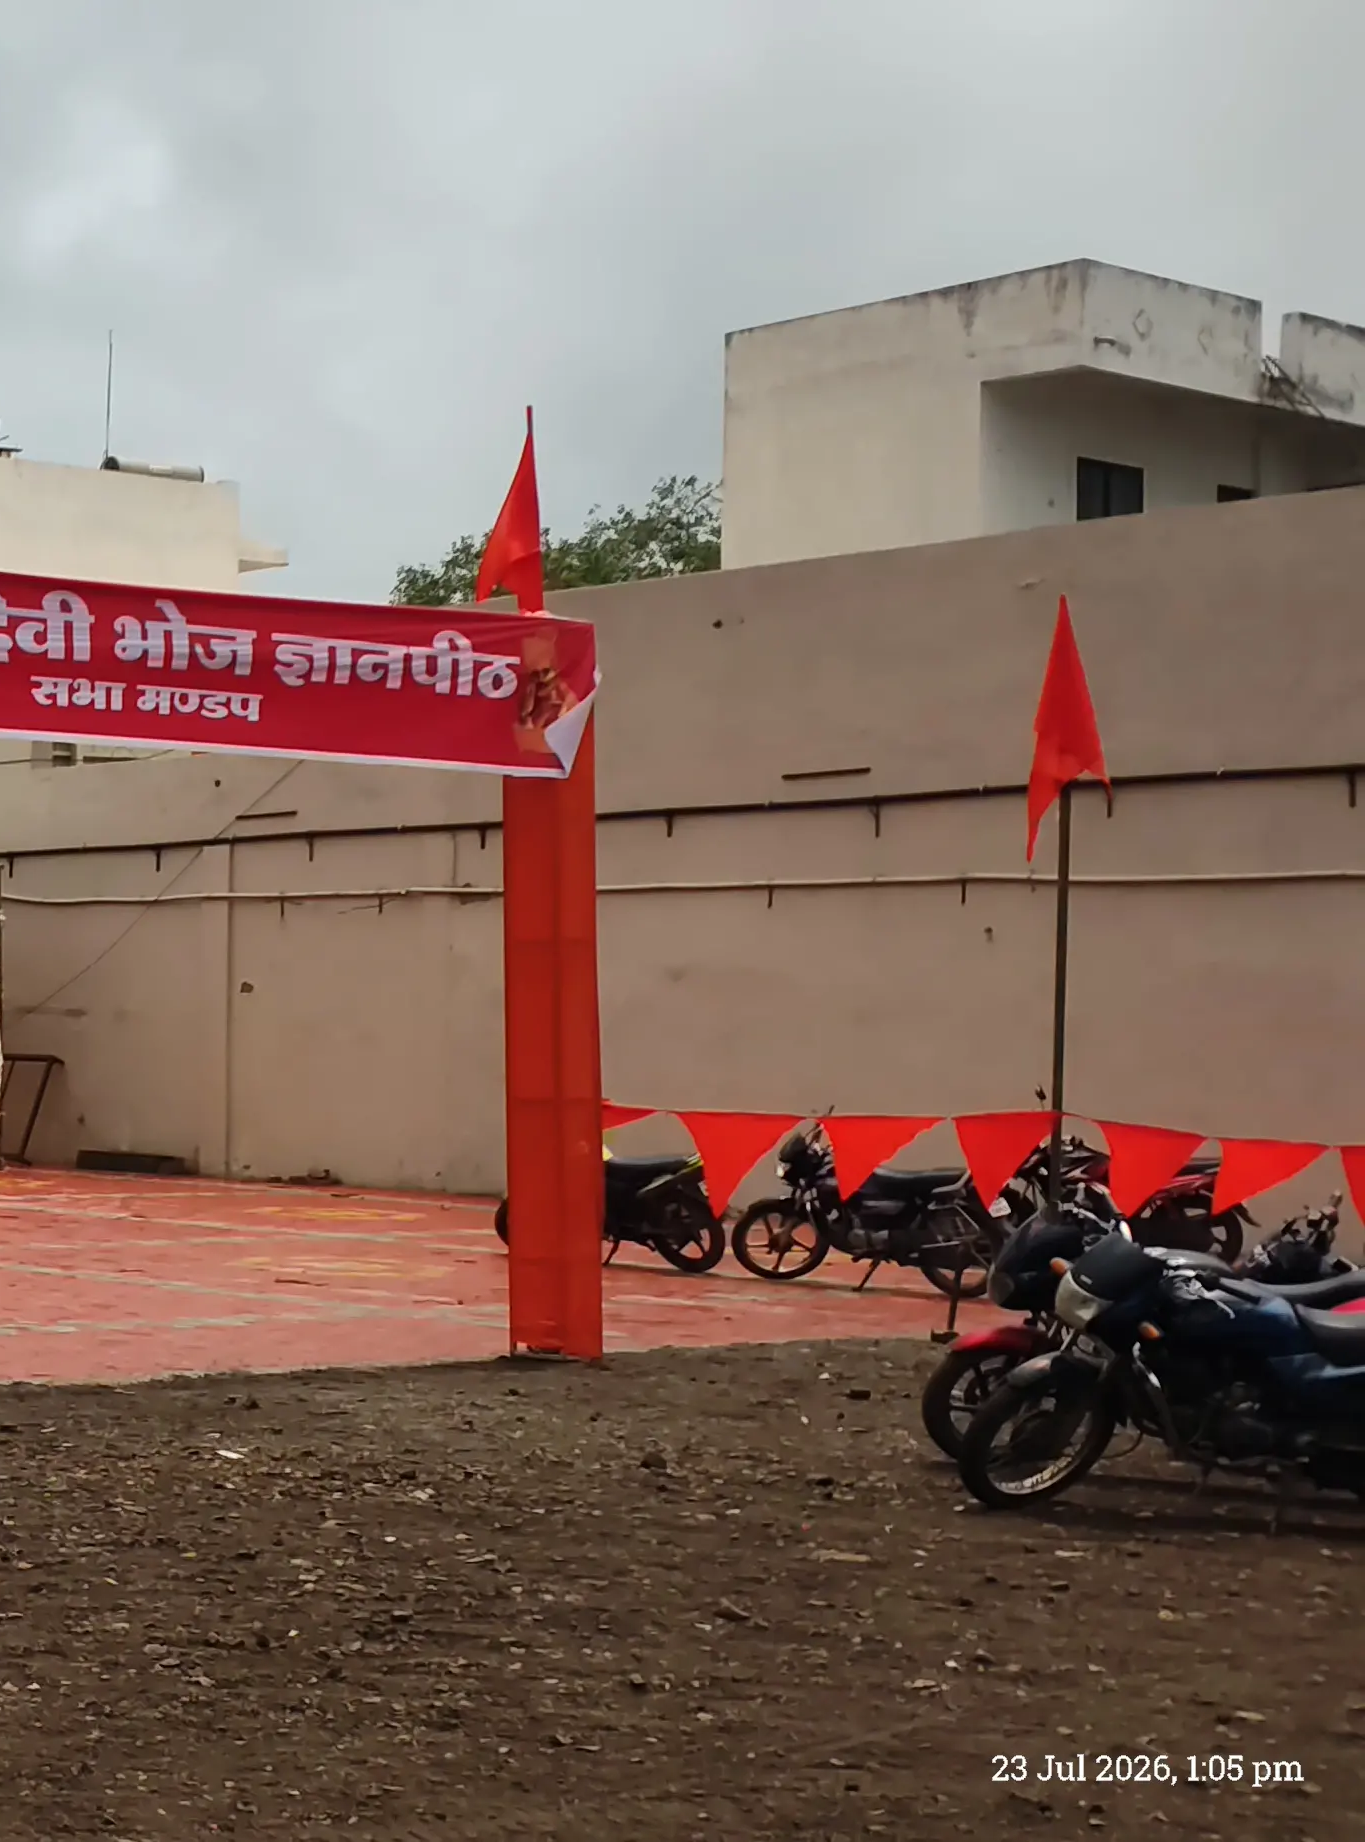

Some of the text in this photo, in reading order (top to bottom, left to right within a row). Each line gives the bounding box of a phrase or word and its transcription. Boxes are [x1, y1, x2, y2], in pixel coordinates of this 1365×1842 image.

[113, 599, 257, 676] भोज
[271, 630, 521, 700] ज्ञानपीठ
[30, 676, 264, 722] सभा मण्डप
